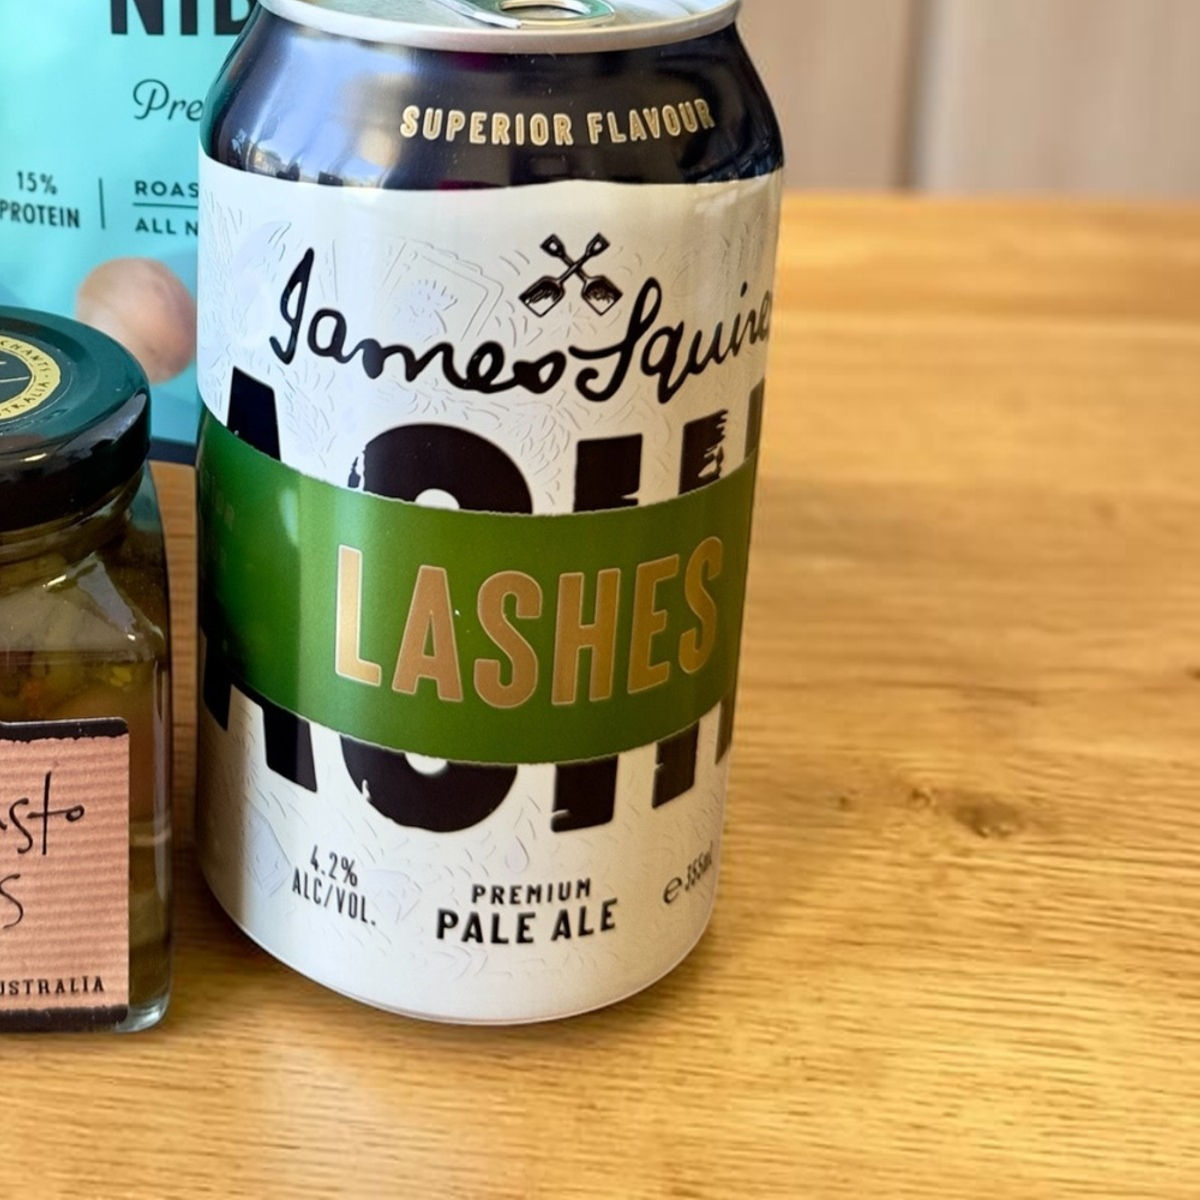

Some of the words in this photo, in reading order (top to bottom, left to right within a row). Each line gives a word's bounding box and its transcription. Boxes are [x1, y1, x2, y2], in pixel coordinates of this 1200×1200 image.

[133, 78, 205, 122] Pre
[400, 104, 573, 147] SUPERIOR
[587, 98, 715, 145] FLAVOUR
[16, 170, 58, 195] 15%
[134, 180, 199, 198] ROAS
[134, 216, 177, 236] ALL
[270, 246, 570, 395] James
[334, 536, 724, 710] LASHES
[309, 844, 358, 887] 4.2%
[291, 866, 377, 927] ALC/VOL.
[471, 878, 591, 905] PREMIUM
[436, 907, 537, 945] PALE
[550, 897, 618, 942] ALE
